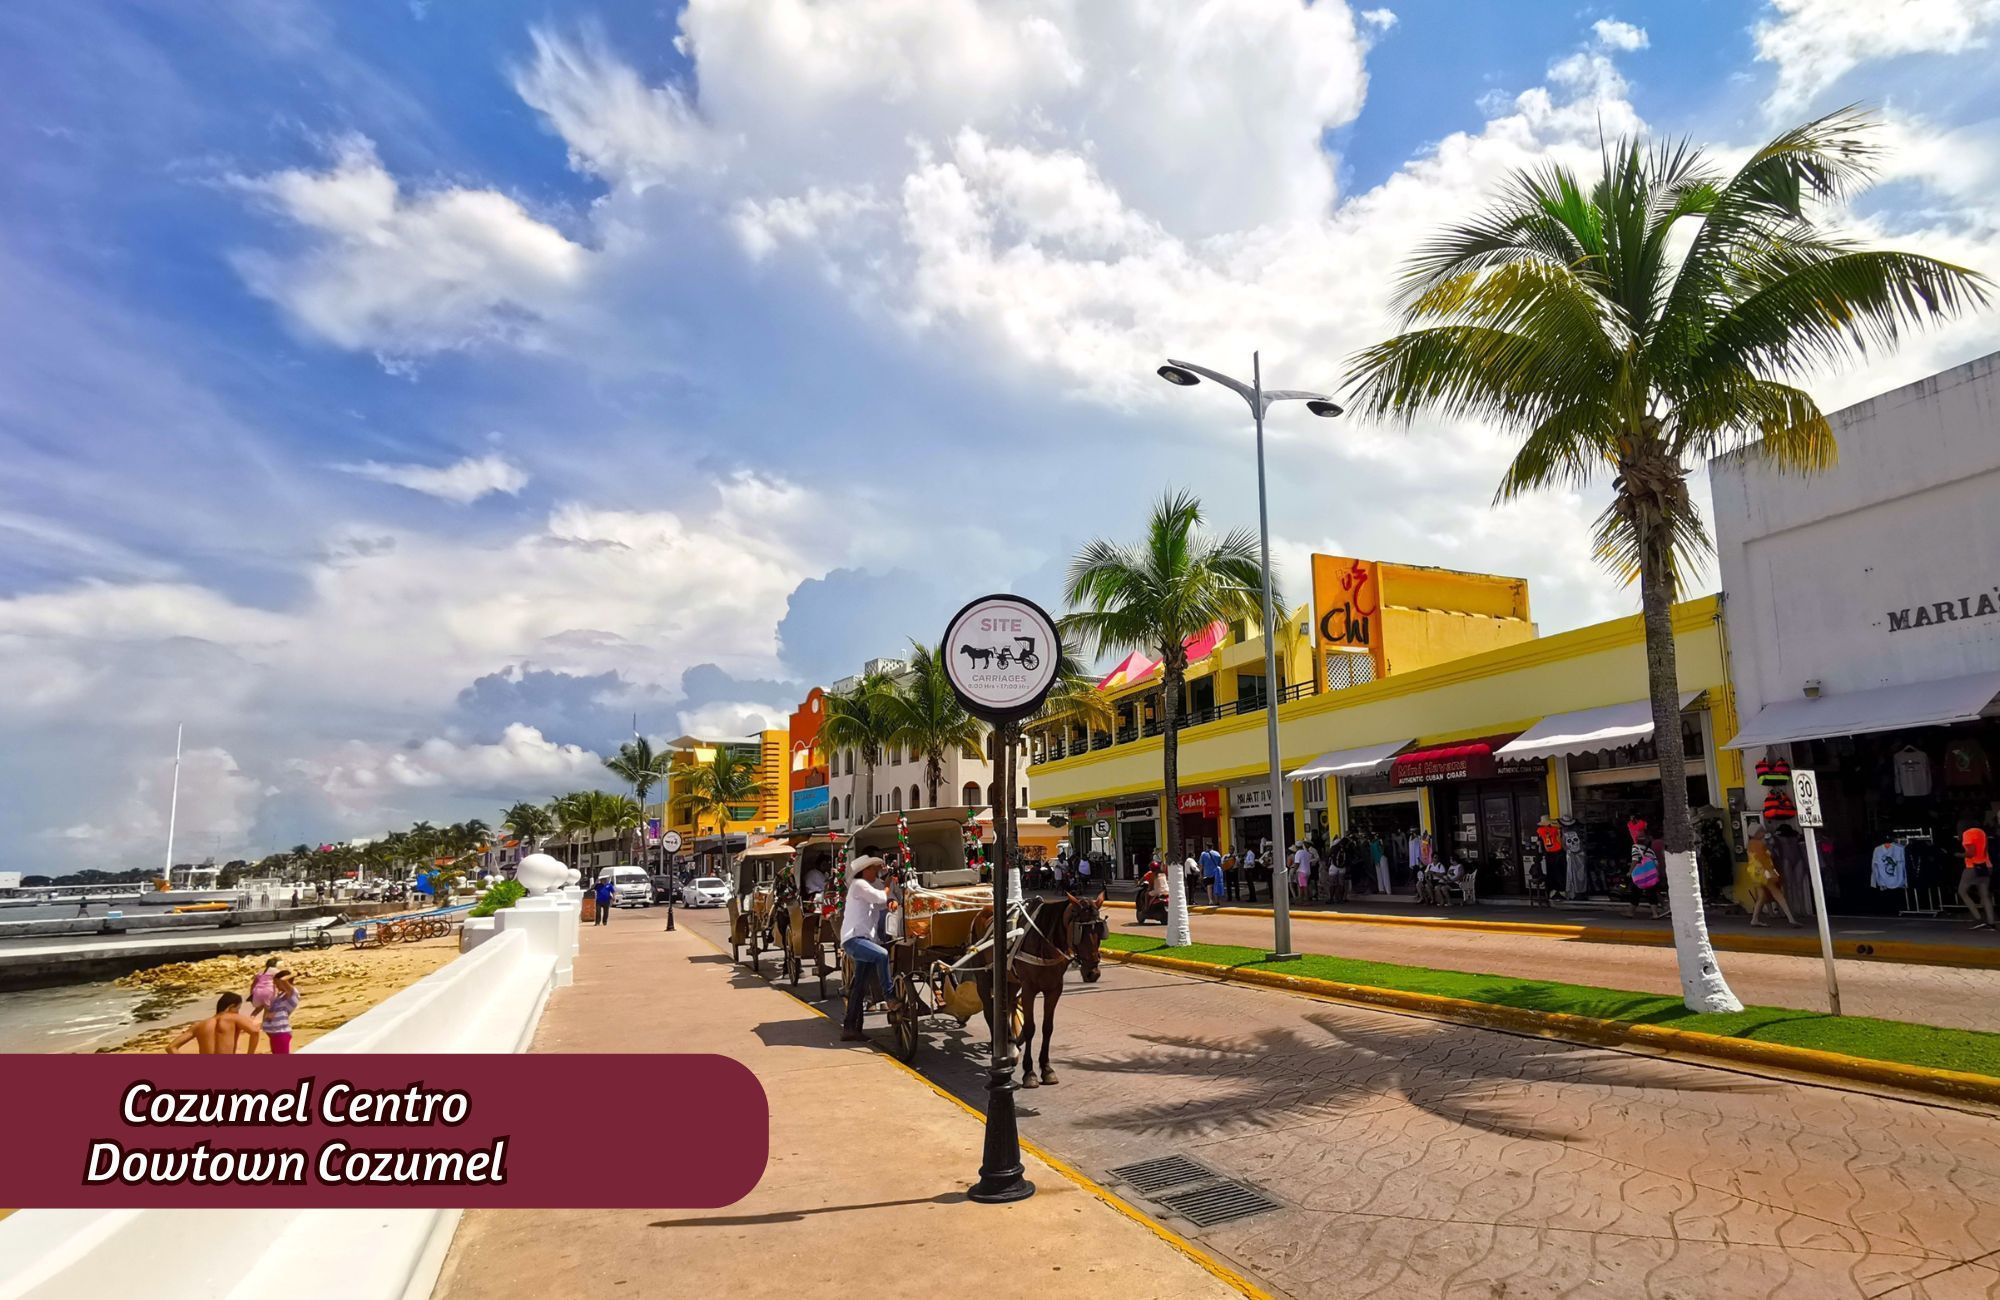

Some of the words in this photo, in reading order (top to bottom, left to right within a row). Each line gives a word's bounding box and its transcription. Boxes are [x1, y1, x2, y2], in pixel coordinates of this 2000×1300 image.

[1887, 586, 2000, 632] MARIA'
[980, 618, 1022, 632] SITE
[971, 674, 1027, 682] CARRIAGES
[1398, 776, 1425, 785] AUTHENTIC
[1426, 773, 1444, 782] CUBAN
[1446, 770, 1467, 780] CIGARS
[1798, 780, 1812, 798] 30
